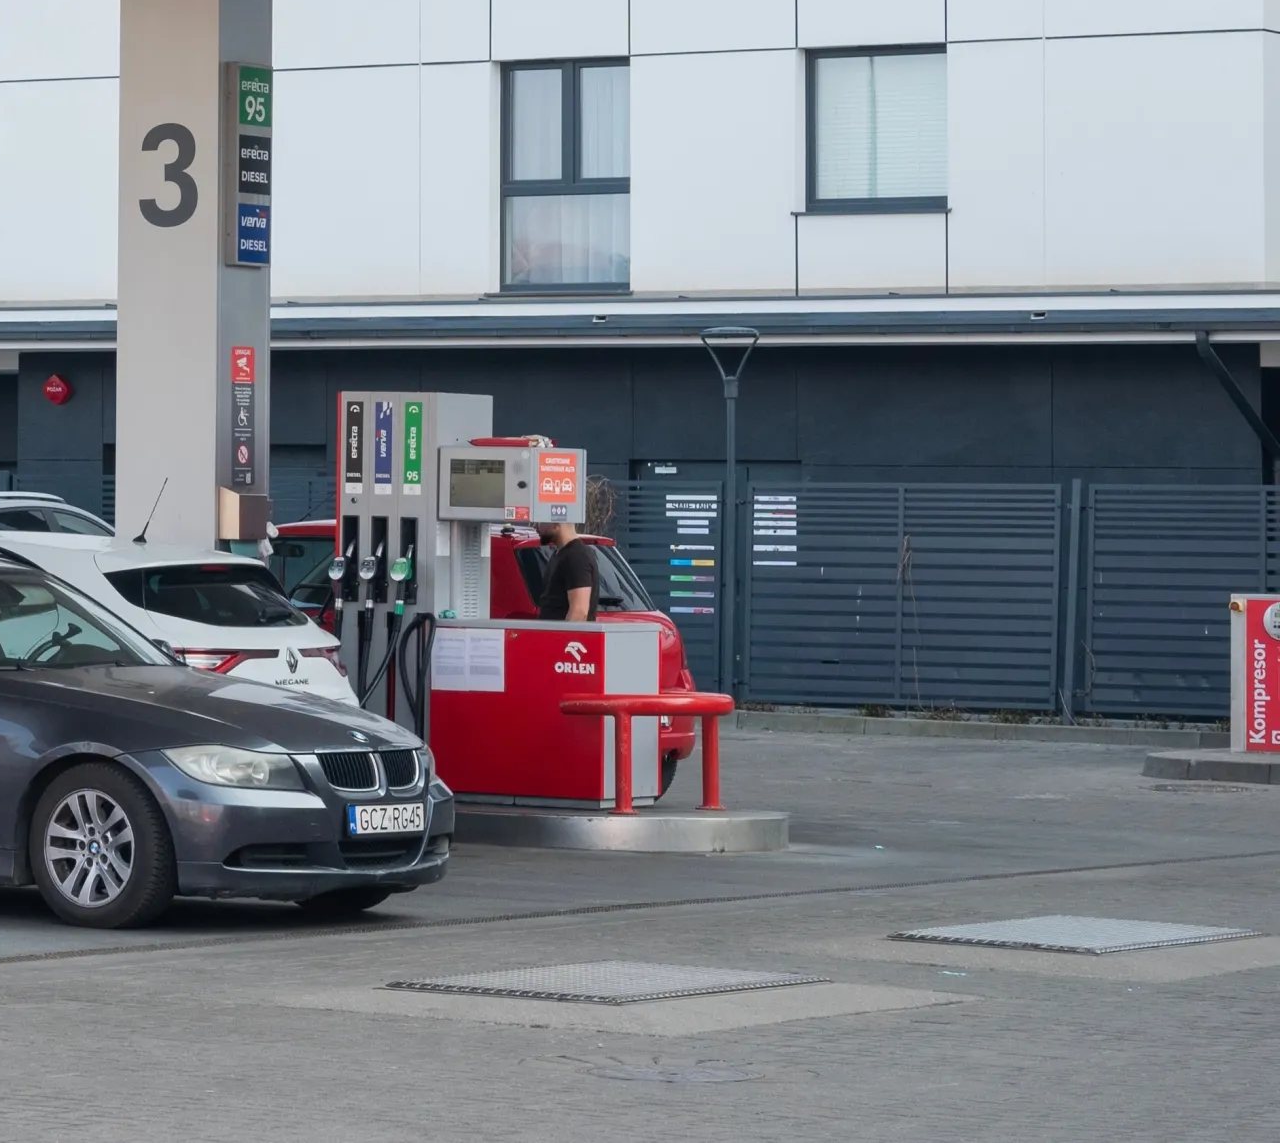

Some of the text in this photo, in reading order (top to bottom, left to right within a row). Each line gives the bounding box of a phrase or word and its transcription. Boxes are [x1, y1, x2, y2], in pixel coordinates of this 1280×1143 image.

[245, 95, 266, 122] 95
[138, 122, 199, 228] 3
[241, 170, 268, 184] DIESEL
[240, 215, 267, 229] verva
[240, 238, 267, 252] DIESEL
[406, 470, 419, 482] 95
[554, 661, 595, 675] ORLEN
[275, 678, 309, 686] MEGANE
[1249, 639, 1271, 744] Kompresor
[359, 807, 388, 831] GCZ
[392, 805, 421, 830] RG45
